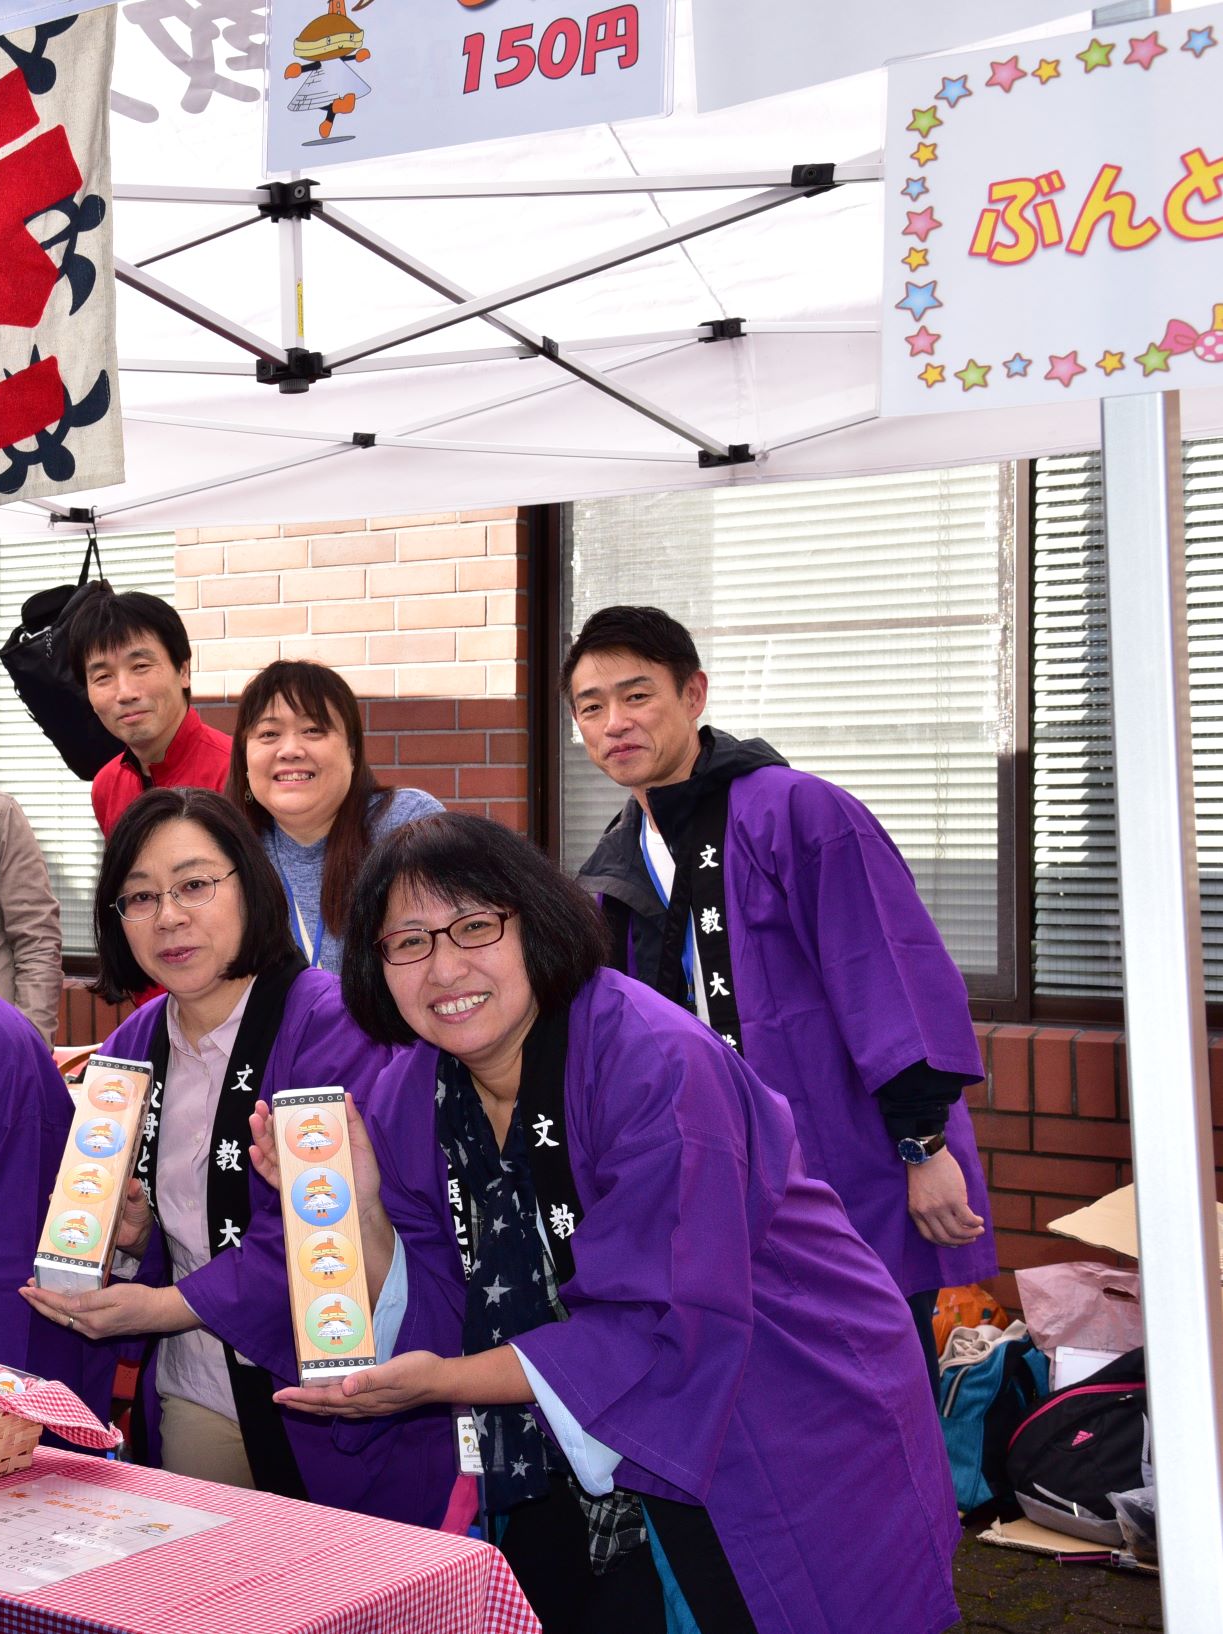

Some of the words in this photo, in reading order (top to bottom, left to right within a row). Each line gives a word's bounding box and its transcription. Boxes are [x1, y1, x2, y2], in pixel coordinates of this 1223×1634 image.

[462, 4, 640, 95] 150円
[215, 1063, 254, 1248] 文教大
